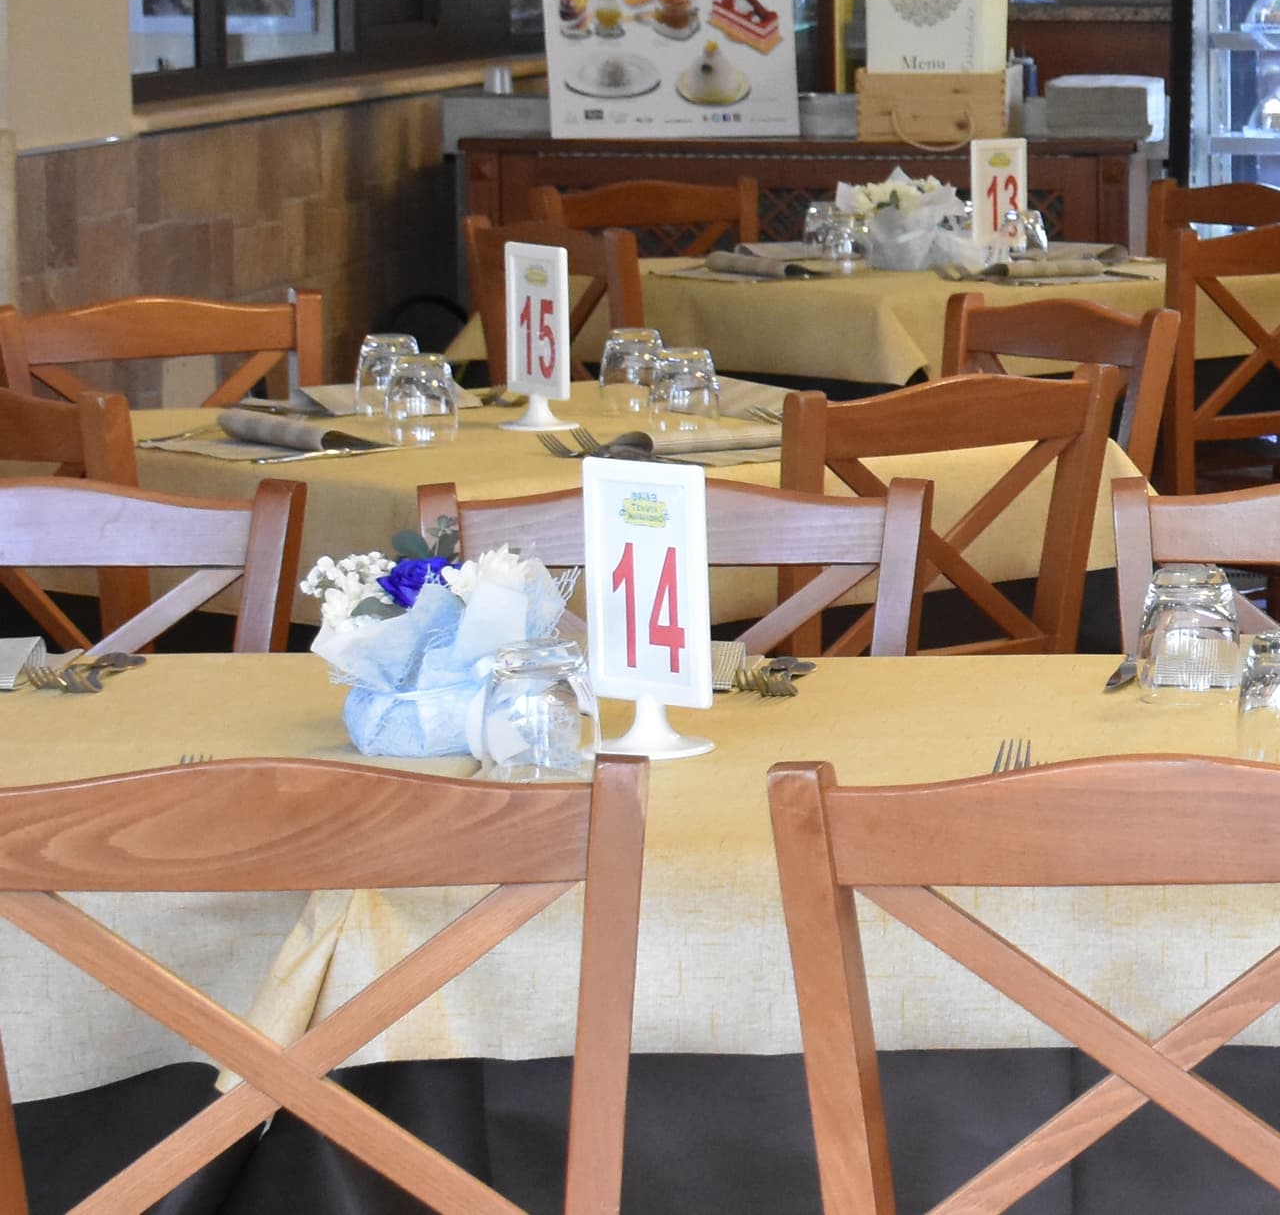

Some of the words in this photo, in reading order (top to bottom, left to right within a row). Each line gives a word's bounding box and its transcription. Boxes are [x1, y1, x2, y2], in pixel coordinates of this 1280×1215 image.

[902, 56, 946, 71] Menu
[987, 175, 1019, 237] 13
[520, 295, 556, 379] 15
[612, 542, 686, 673] 14
